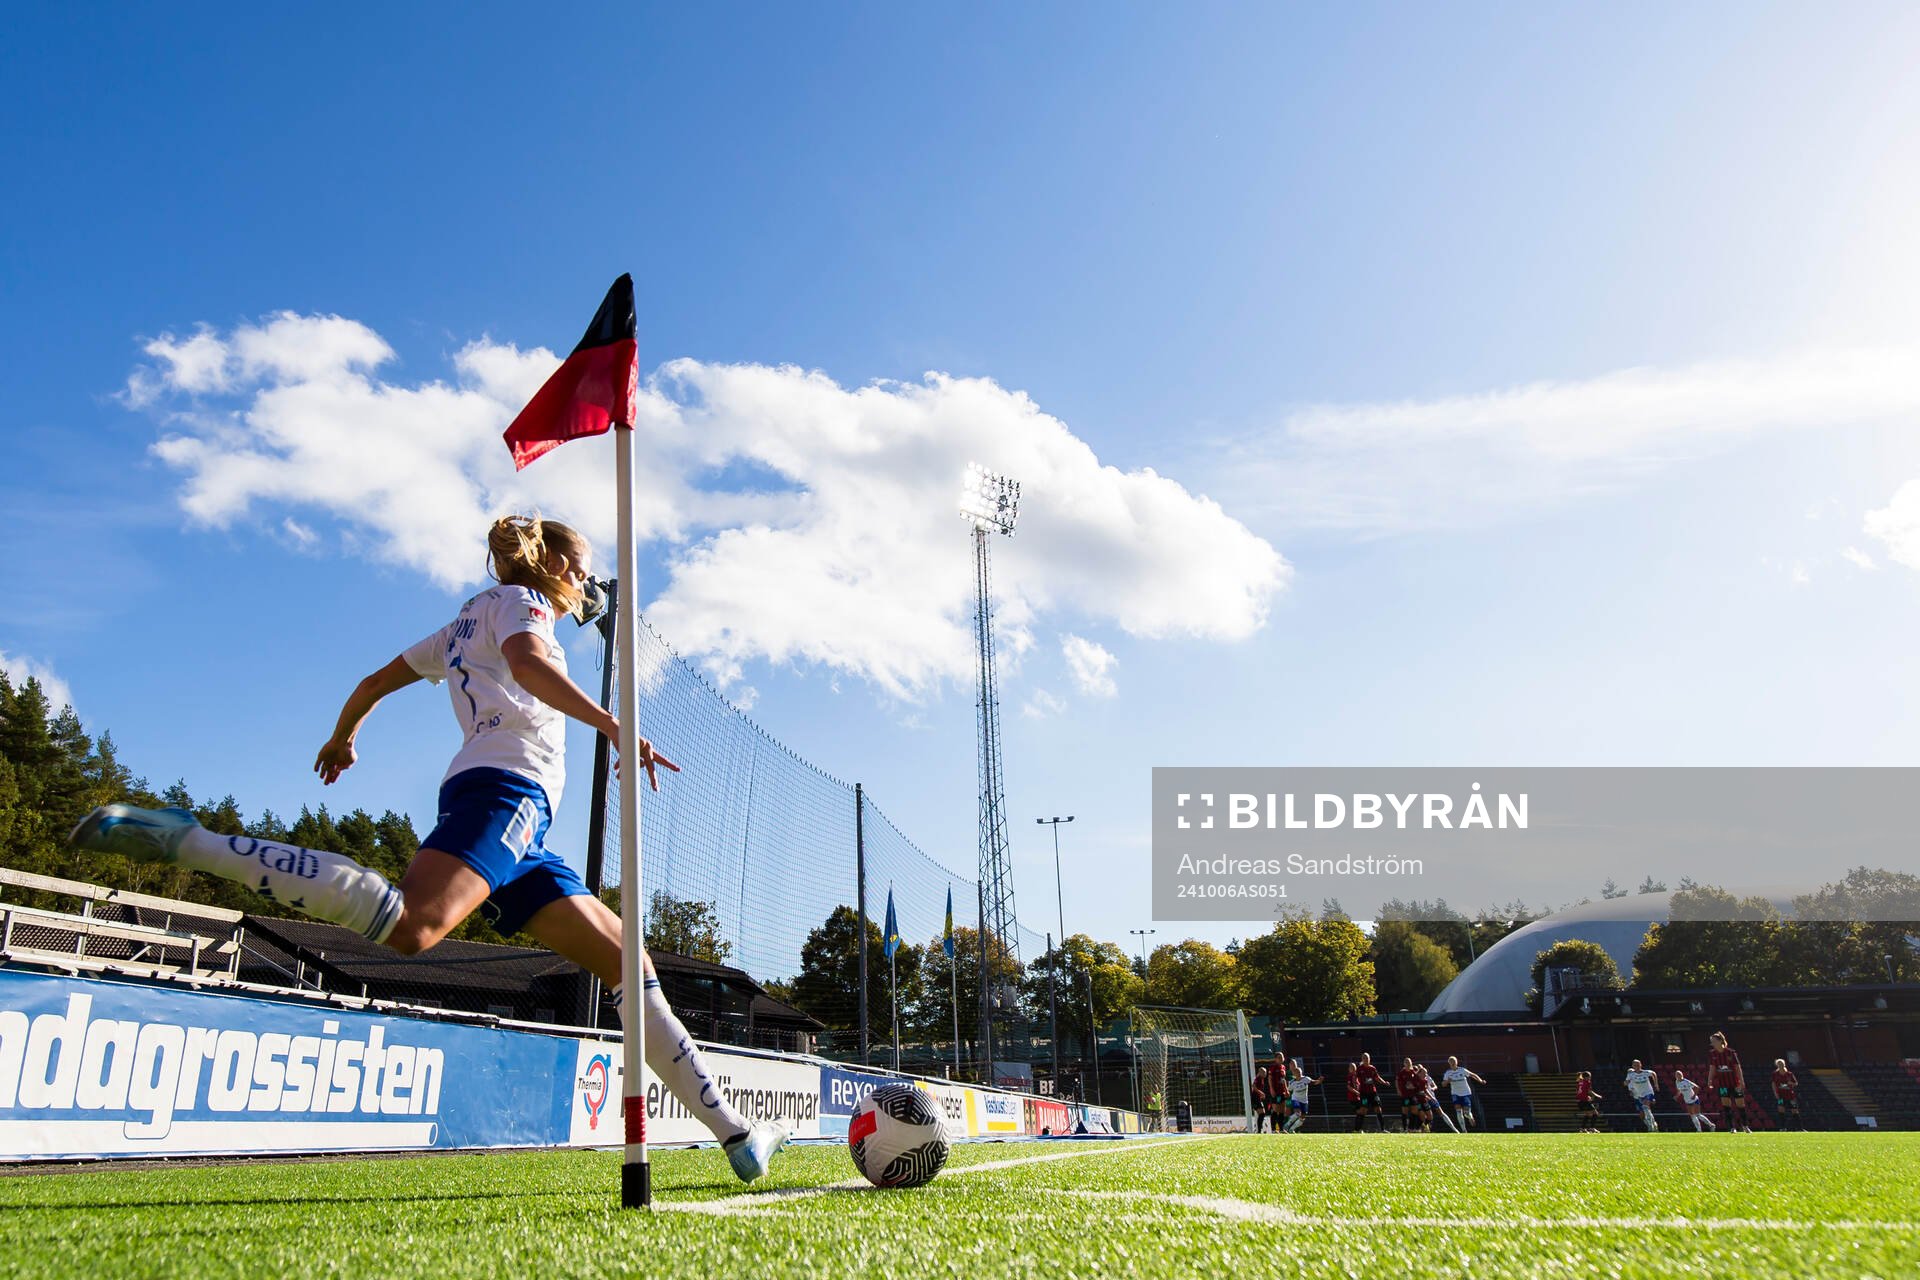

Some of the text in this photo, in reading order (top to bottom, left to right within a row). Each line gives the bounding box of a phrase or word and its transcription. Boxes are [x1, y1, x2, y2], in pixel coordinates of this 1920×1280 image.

[228, 835, 320, 879] Ocab
[577, 1077, 603, 1091] Thermia
[712, 1075, 819, 1129] ärmepumpar
[831, 1078, 877, 1110] Rexe
